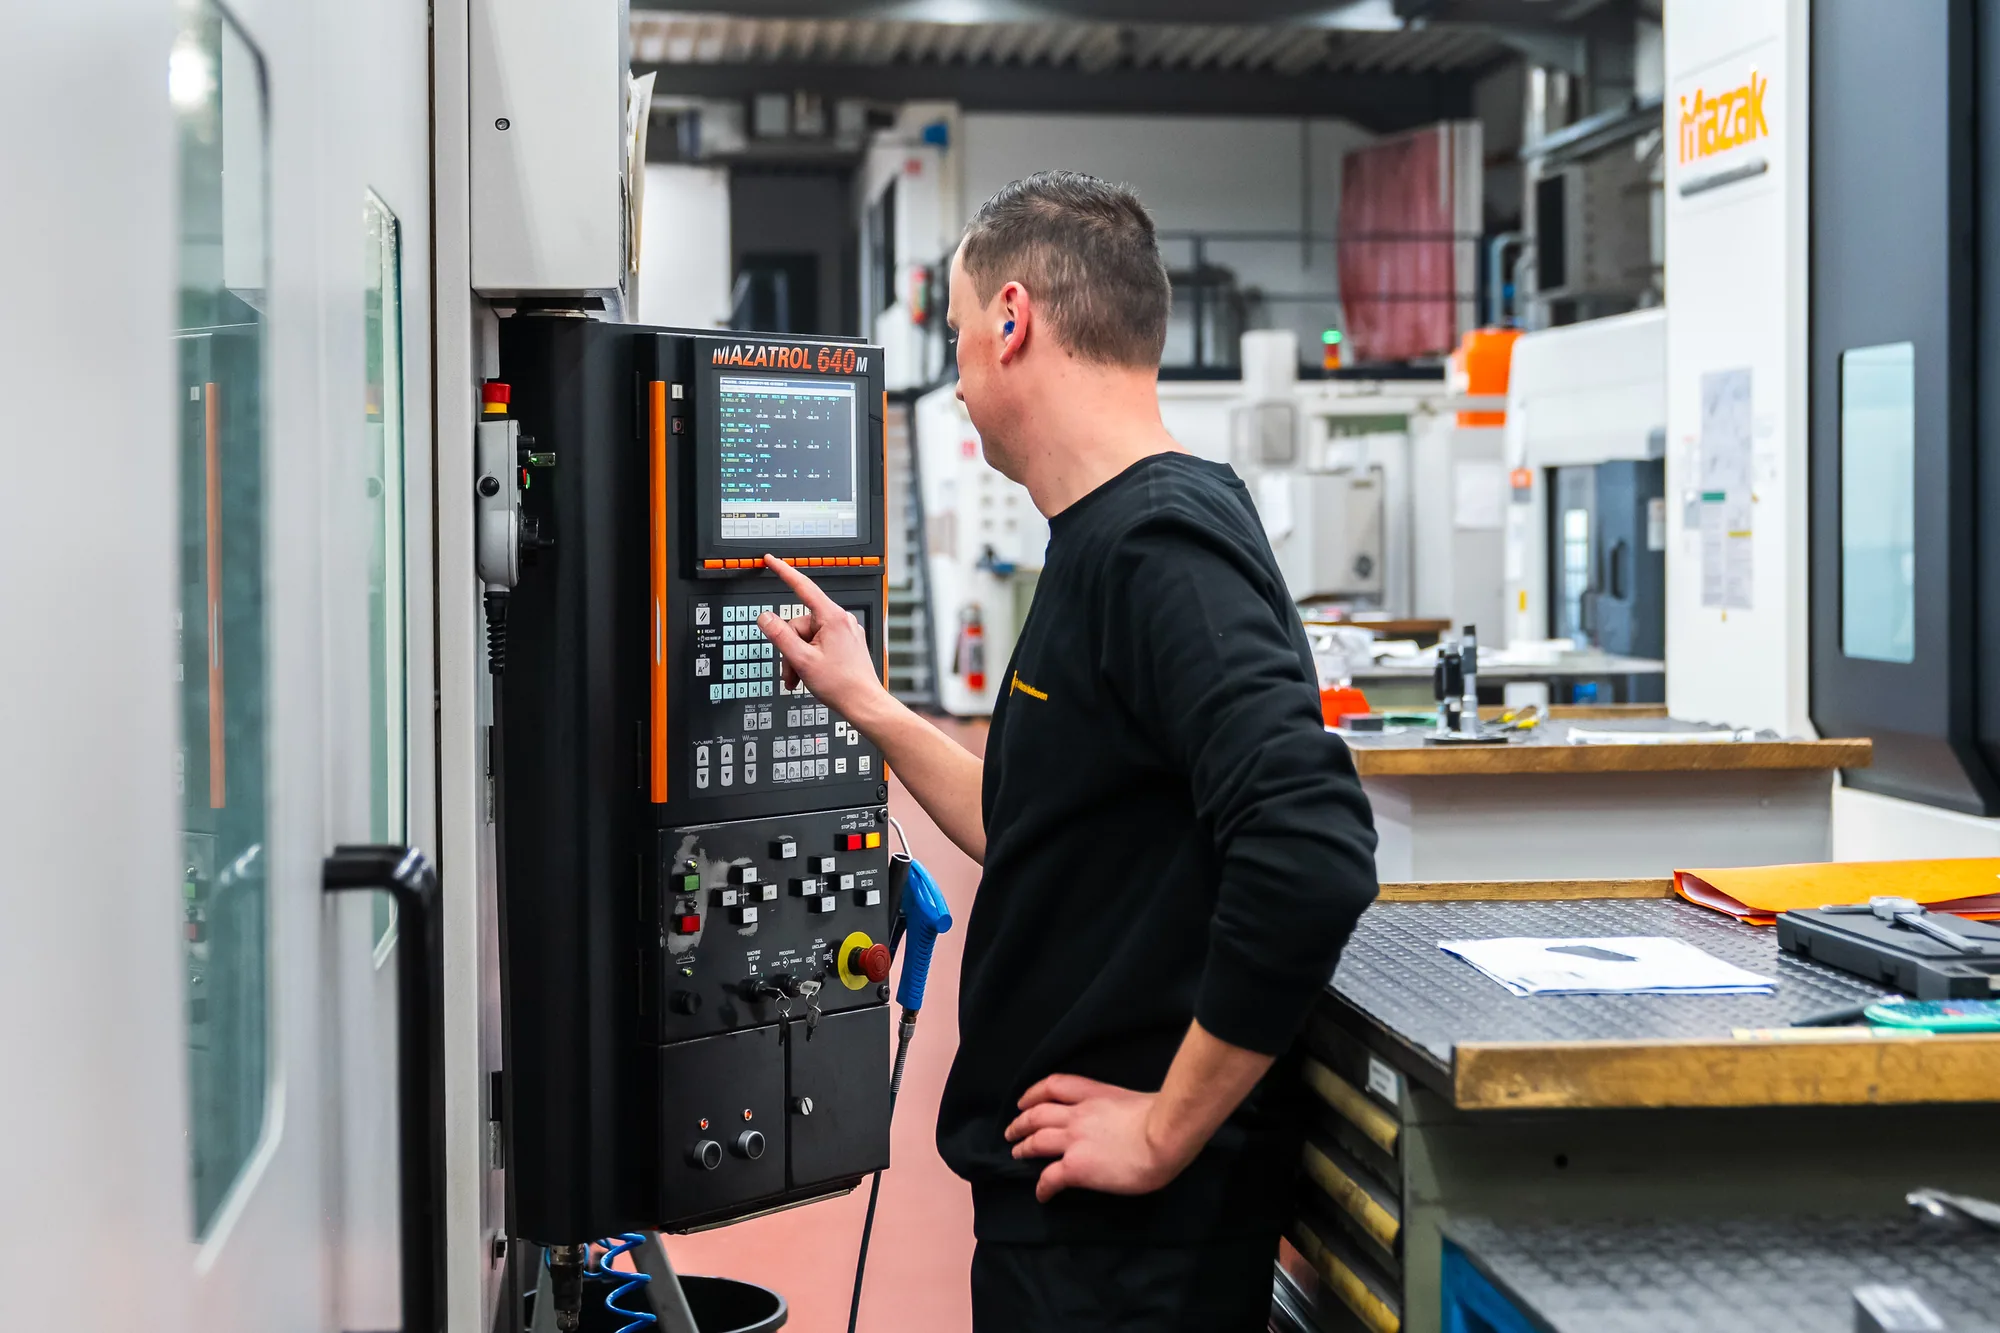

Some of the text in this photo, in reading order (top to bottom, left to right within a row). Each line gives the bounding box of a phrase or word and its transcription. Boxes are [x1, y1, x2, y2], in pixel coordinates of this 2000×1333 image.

[1680, 70, 1767, 163] Mazak
[712, 345, 812, 369] MAZATROL
[740, 686, 744, 694] D
